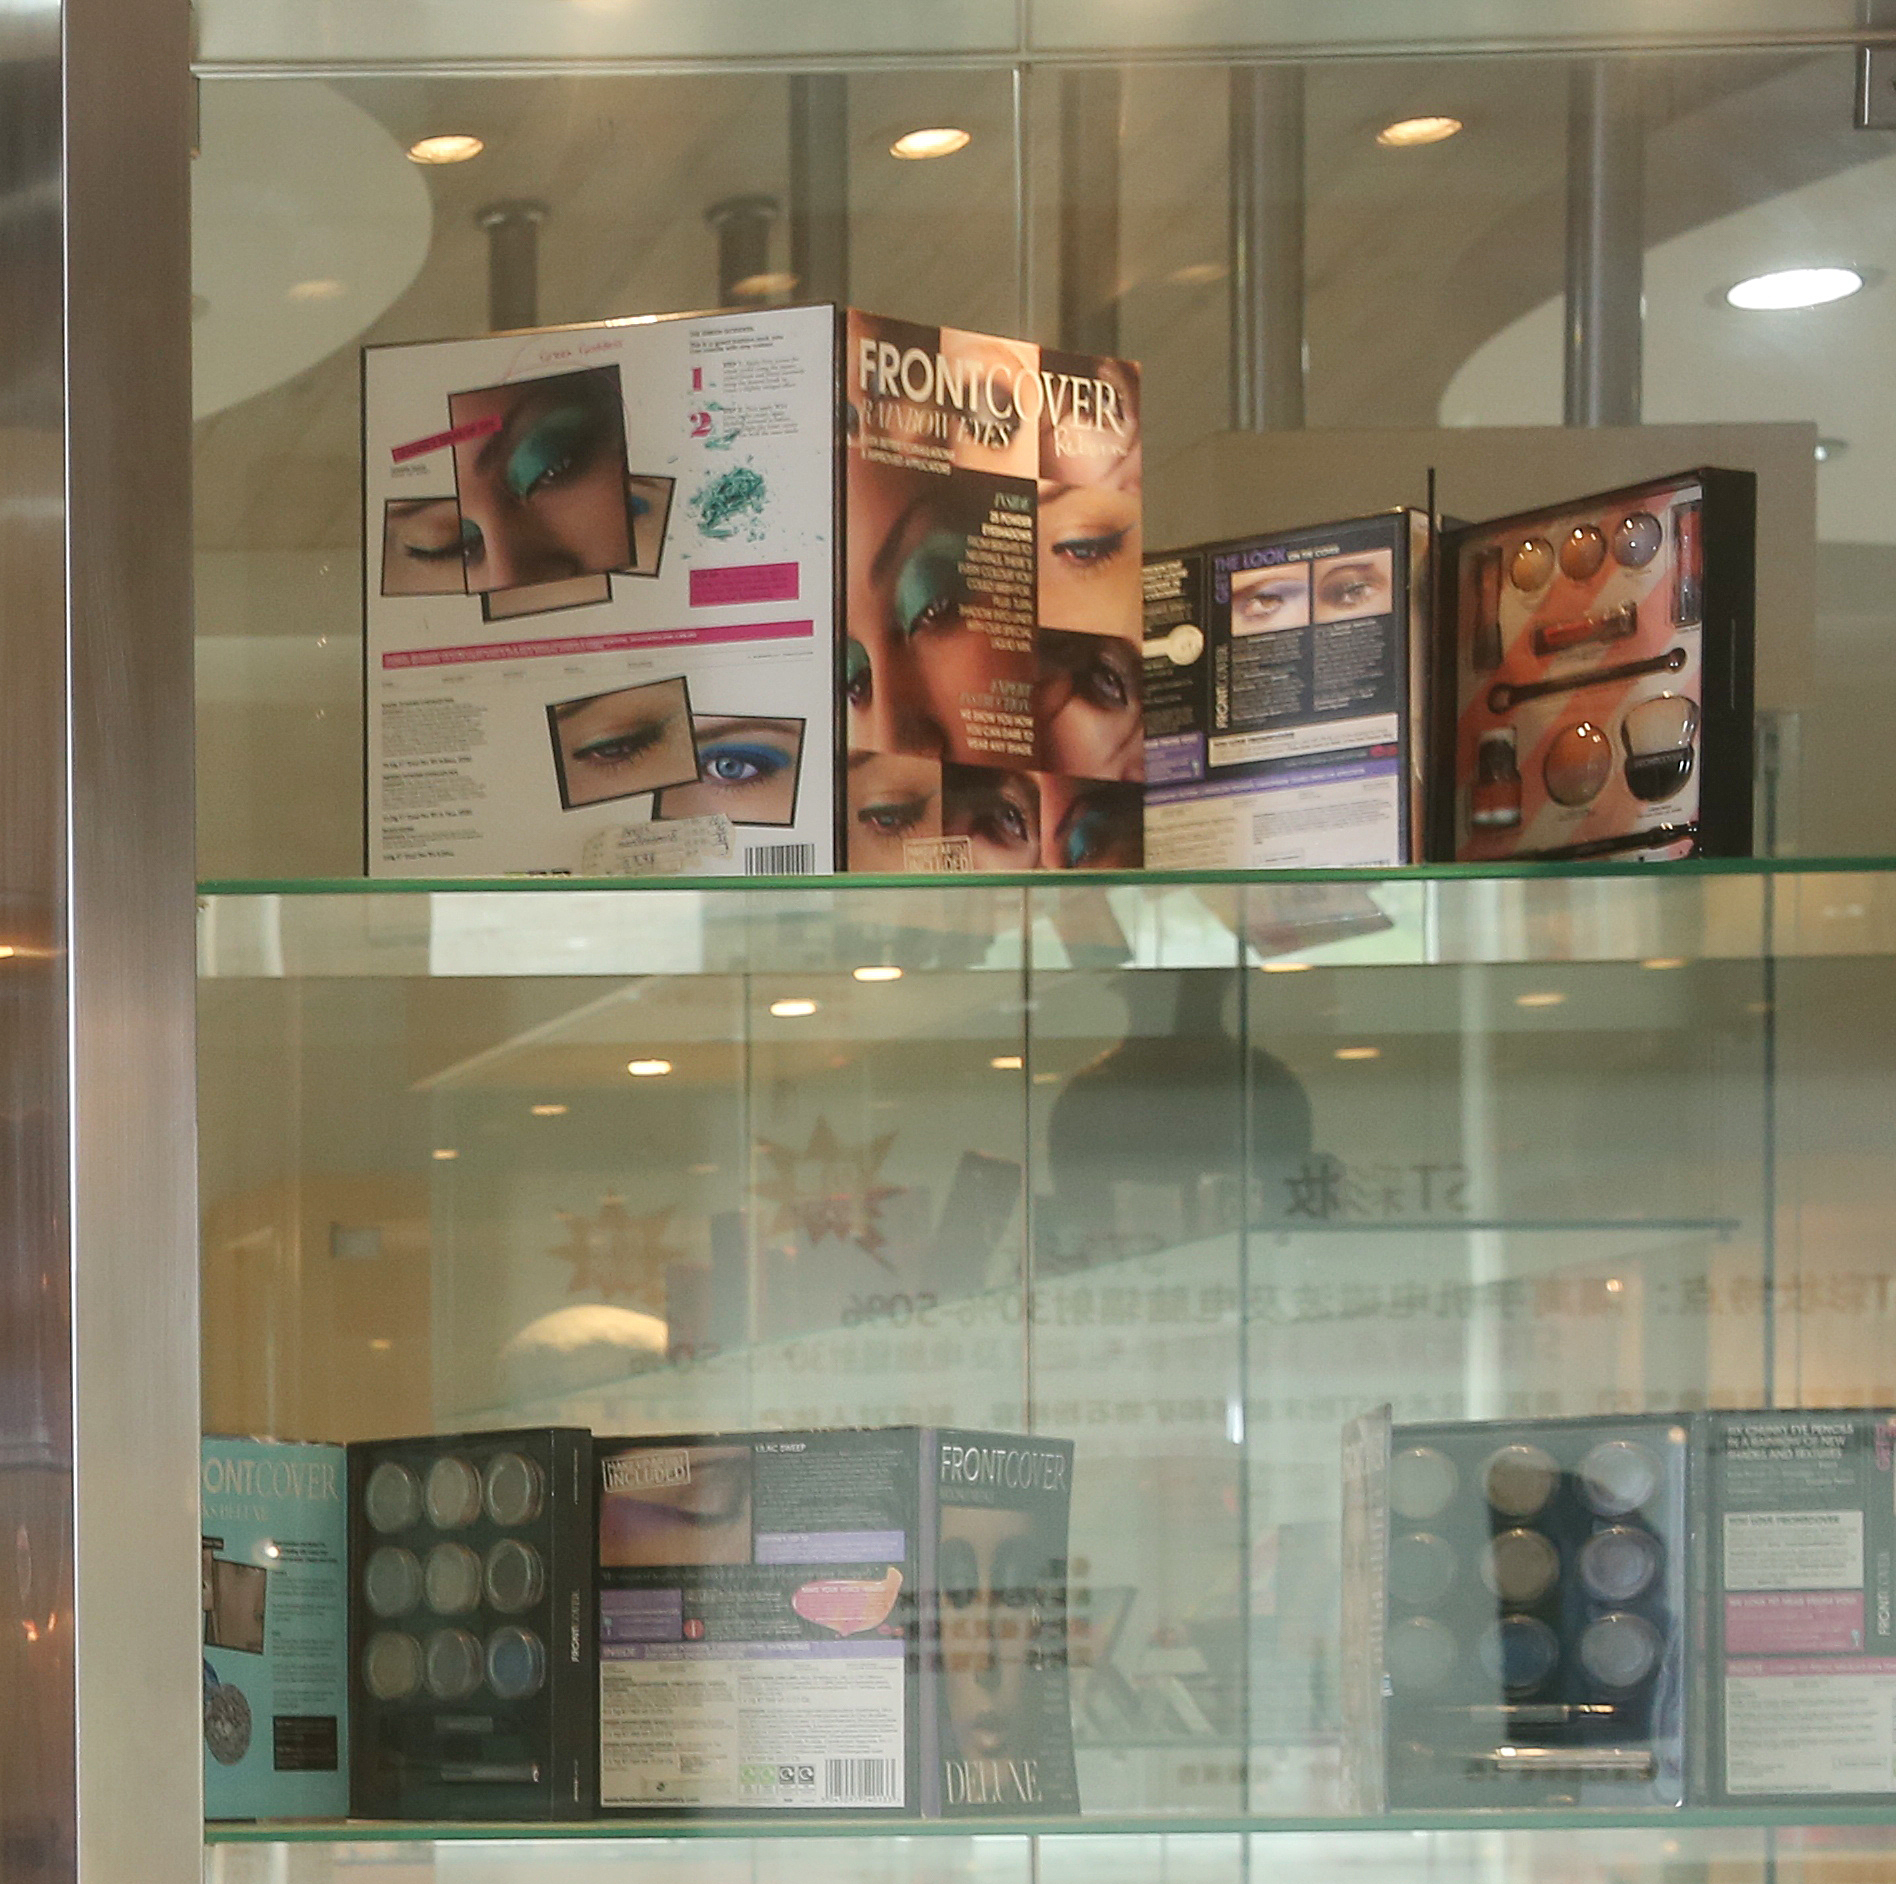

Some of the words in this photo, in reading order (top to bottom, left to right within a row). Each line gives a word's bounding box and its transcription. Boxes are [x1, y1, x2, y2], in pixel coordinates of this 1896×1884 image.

[858, 338, 1125, 436] FRONTCOVER
[690, 411, 712, 438] 2
[863, 400, 948, 440] RAINBOW
[958, 414, 1012, 450] EYES
[756, 1445, 778, 1453] LILAC
[780, 1443, 806, 1452] SWEEP
[608, 1466, 685, 1486] INCLUDED
[942, 1446, 1066, 1491] FRONTCOVER
